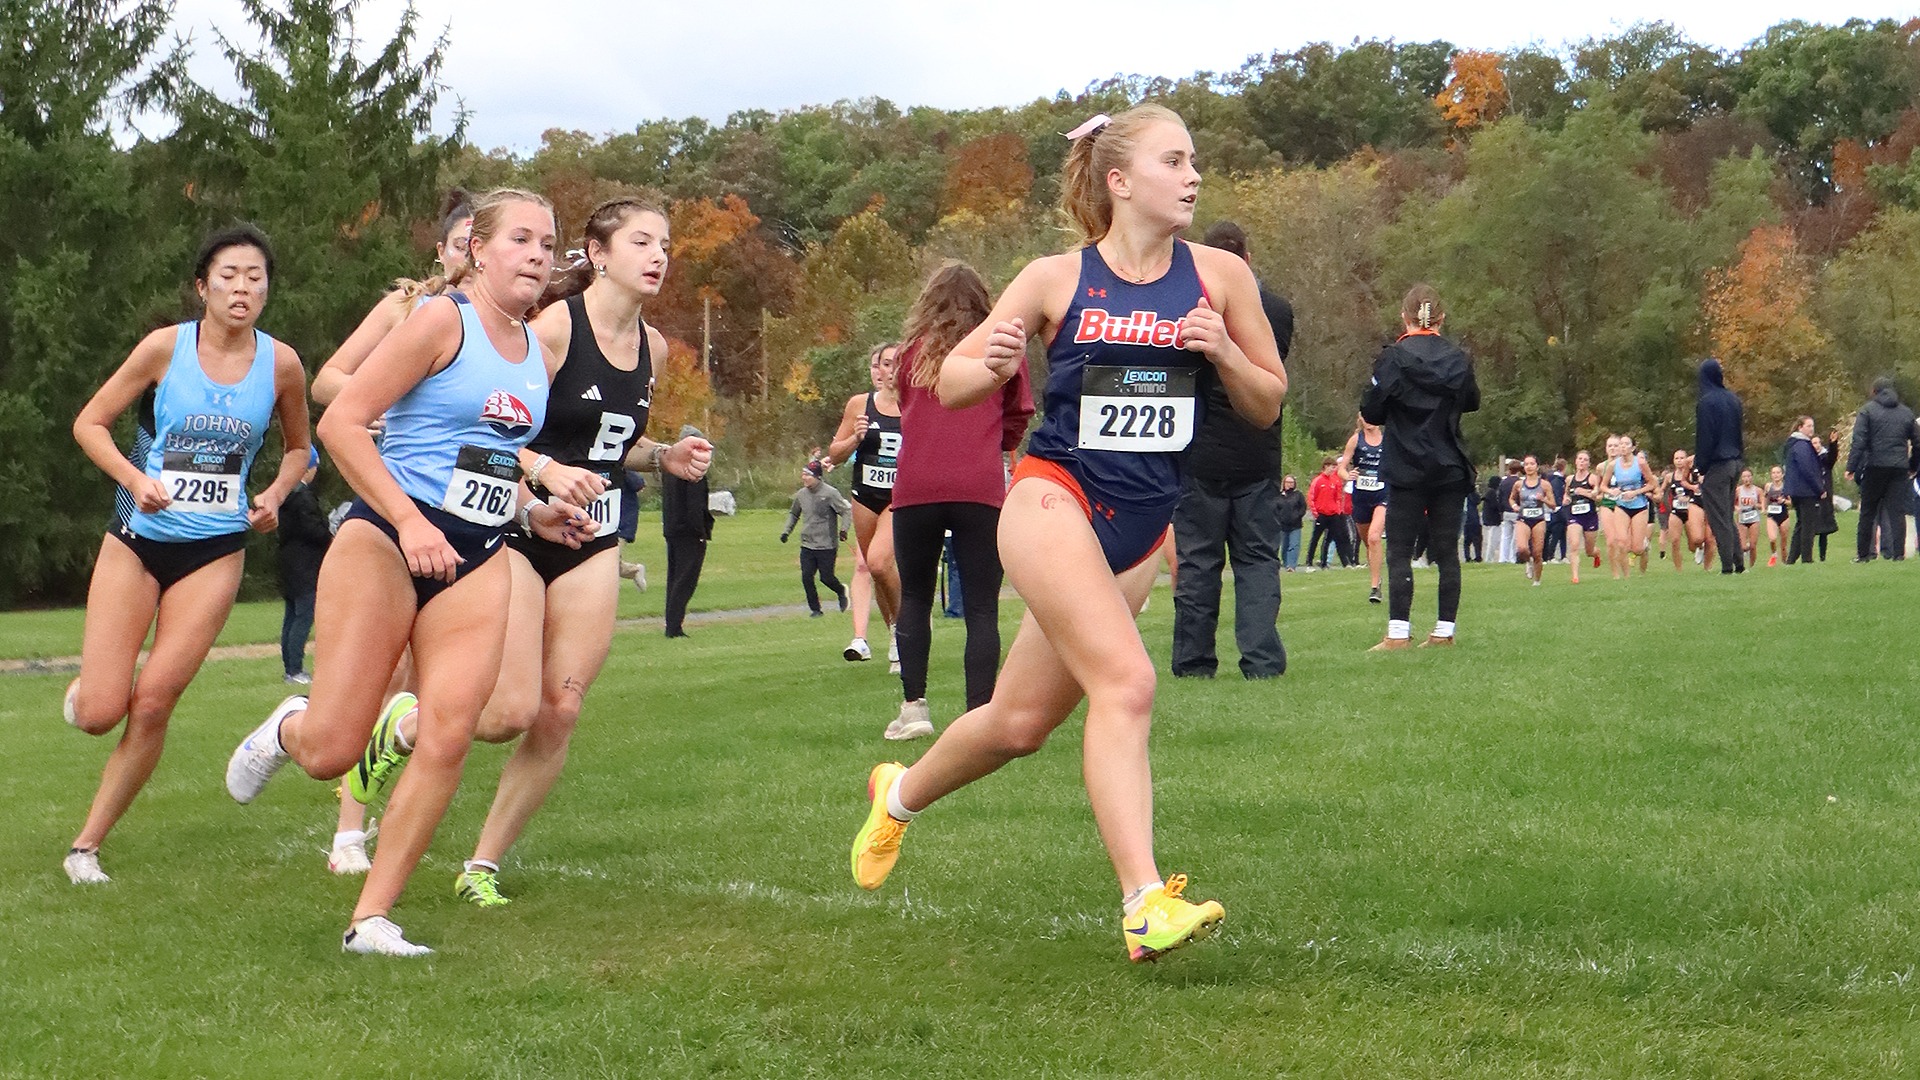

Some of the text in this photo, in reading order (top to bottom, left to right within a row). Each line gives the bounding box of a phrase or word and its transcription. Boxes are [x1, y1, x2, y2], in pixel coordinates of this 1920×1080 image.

[183, 414, 252, 439] JOHNS
[588, 411, 636, 461] B
[1099, 404, 1176, 438] 2228
[173, 478, 228, 503] 2295
[461, 480, 512, 517] 2762
